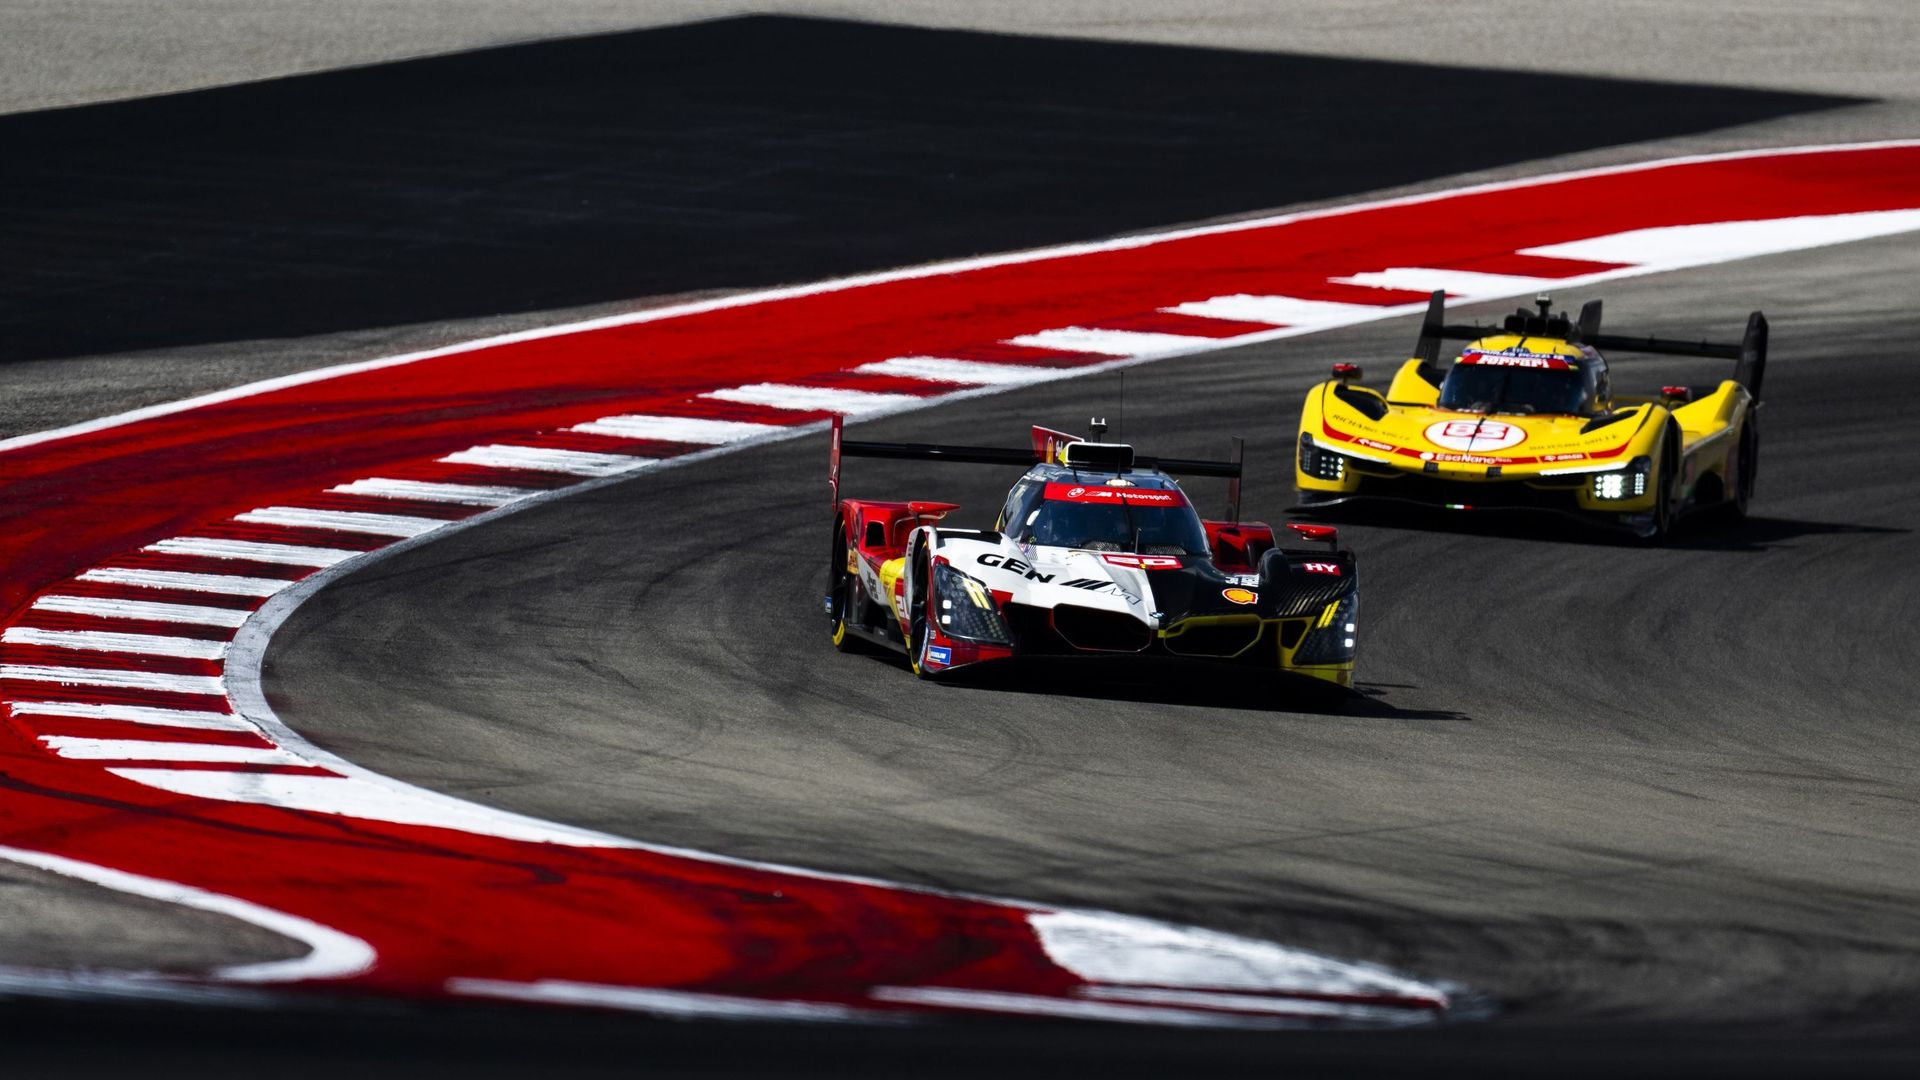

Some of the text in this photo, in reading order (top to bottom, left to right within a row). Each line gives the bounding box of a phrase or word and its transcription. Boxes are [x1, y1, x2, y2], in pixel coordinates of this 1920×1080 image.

[1476, 355, 1550, 368] Ferrari
[1116, 492, 1172, 501] Motorsport
[977, 553, 1056, 584] GEN
[1305, 563, 1337, 573] HY
